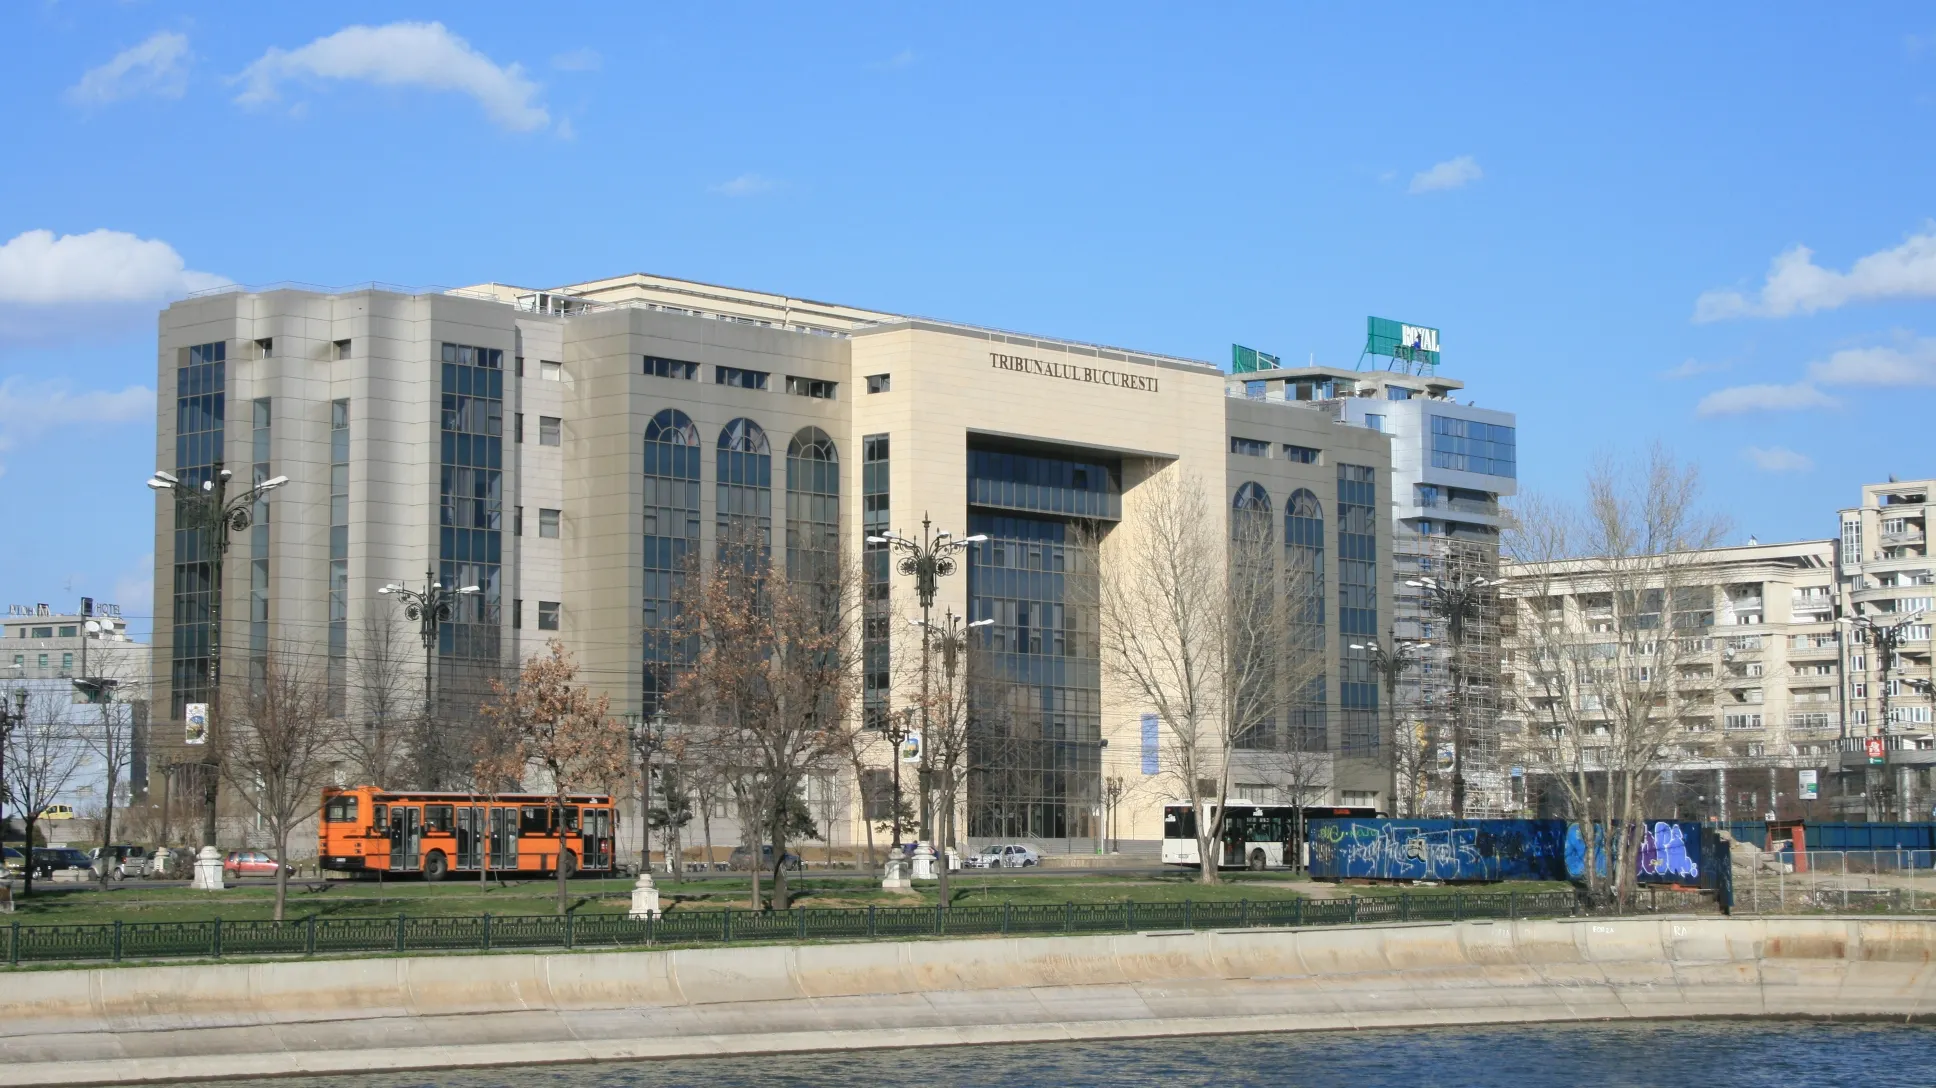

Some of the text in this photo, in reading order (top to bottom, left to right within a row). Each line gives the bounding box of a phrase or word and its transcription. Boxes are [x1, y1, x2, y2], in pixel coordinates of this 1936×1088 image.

[1402, 323, 1440, 353] ROYAL
[989, 352, 1159, 393] TRIBUNALUL BUCURESTI
[96, 602, 122, 616] HOTEL
